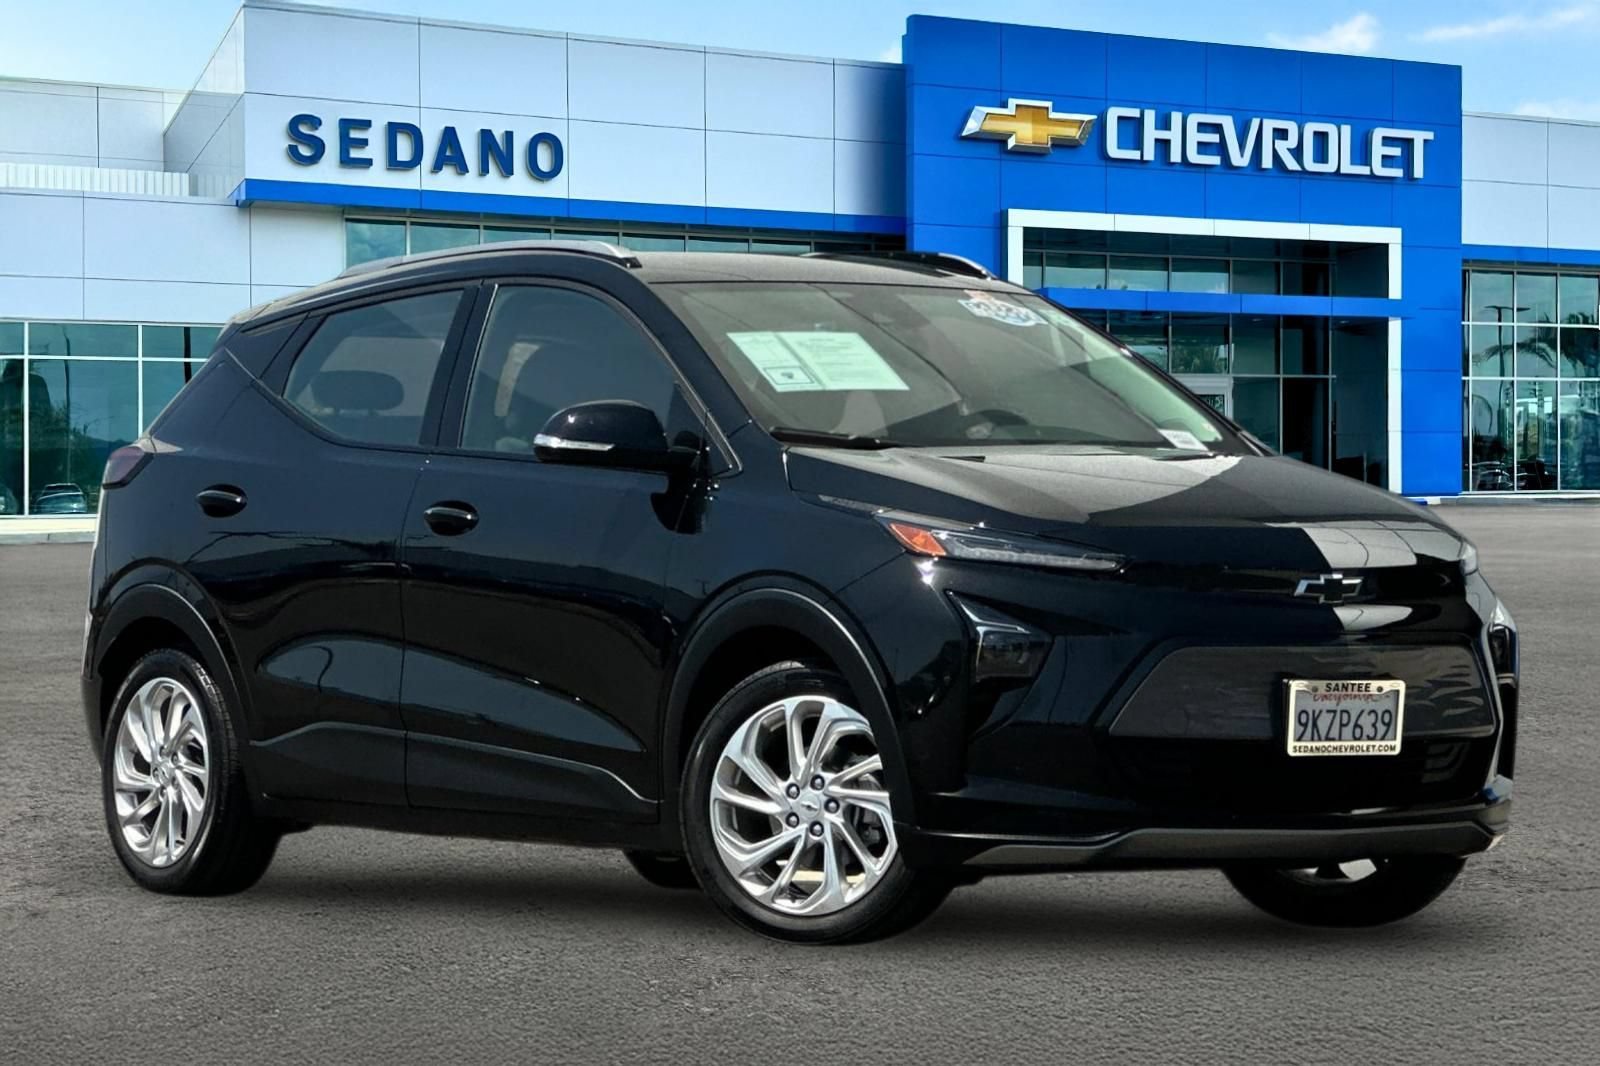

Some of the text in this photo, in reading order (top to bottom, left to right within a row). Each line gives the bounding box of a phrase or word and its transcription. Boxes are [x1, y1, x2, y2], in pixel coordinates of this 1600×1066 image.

[286, 113, 564, 182] SEDANO
[1105, 106, 1435, 179] CHEVROLET
[1325, 683, 1371, 692] SANTEE
[1297, 709, 1393, 741] 9KZP639
[1292, 744, 1396, 753] SEDANOCHEVROLET.COM
